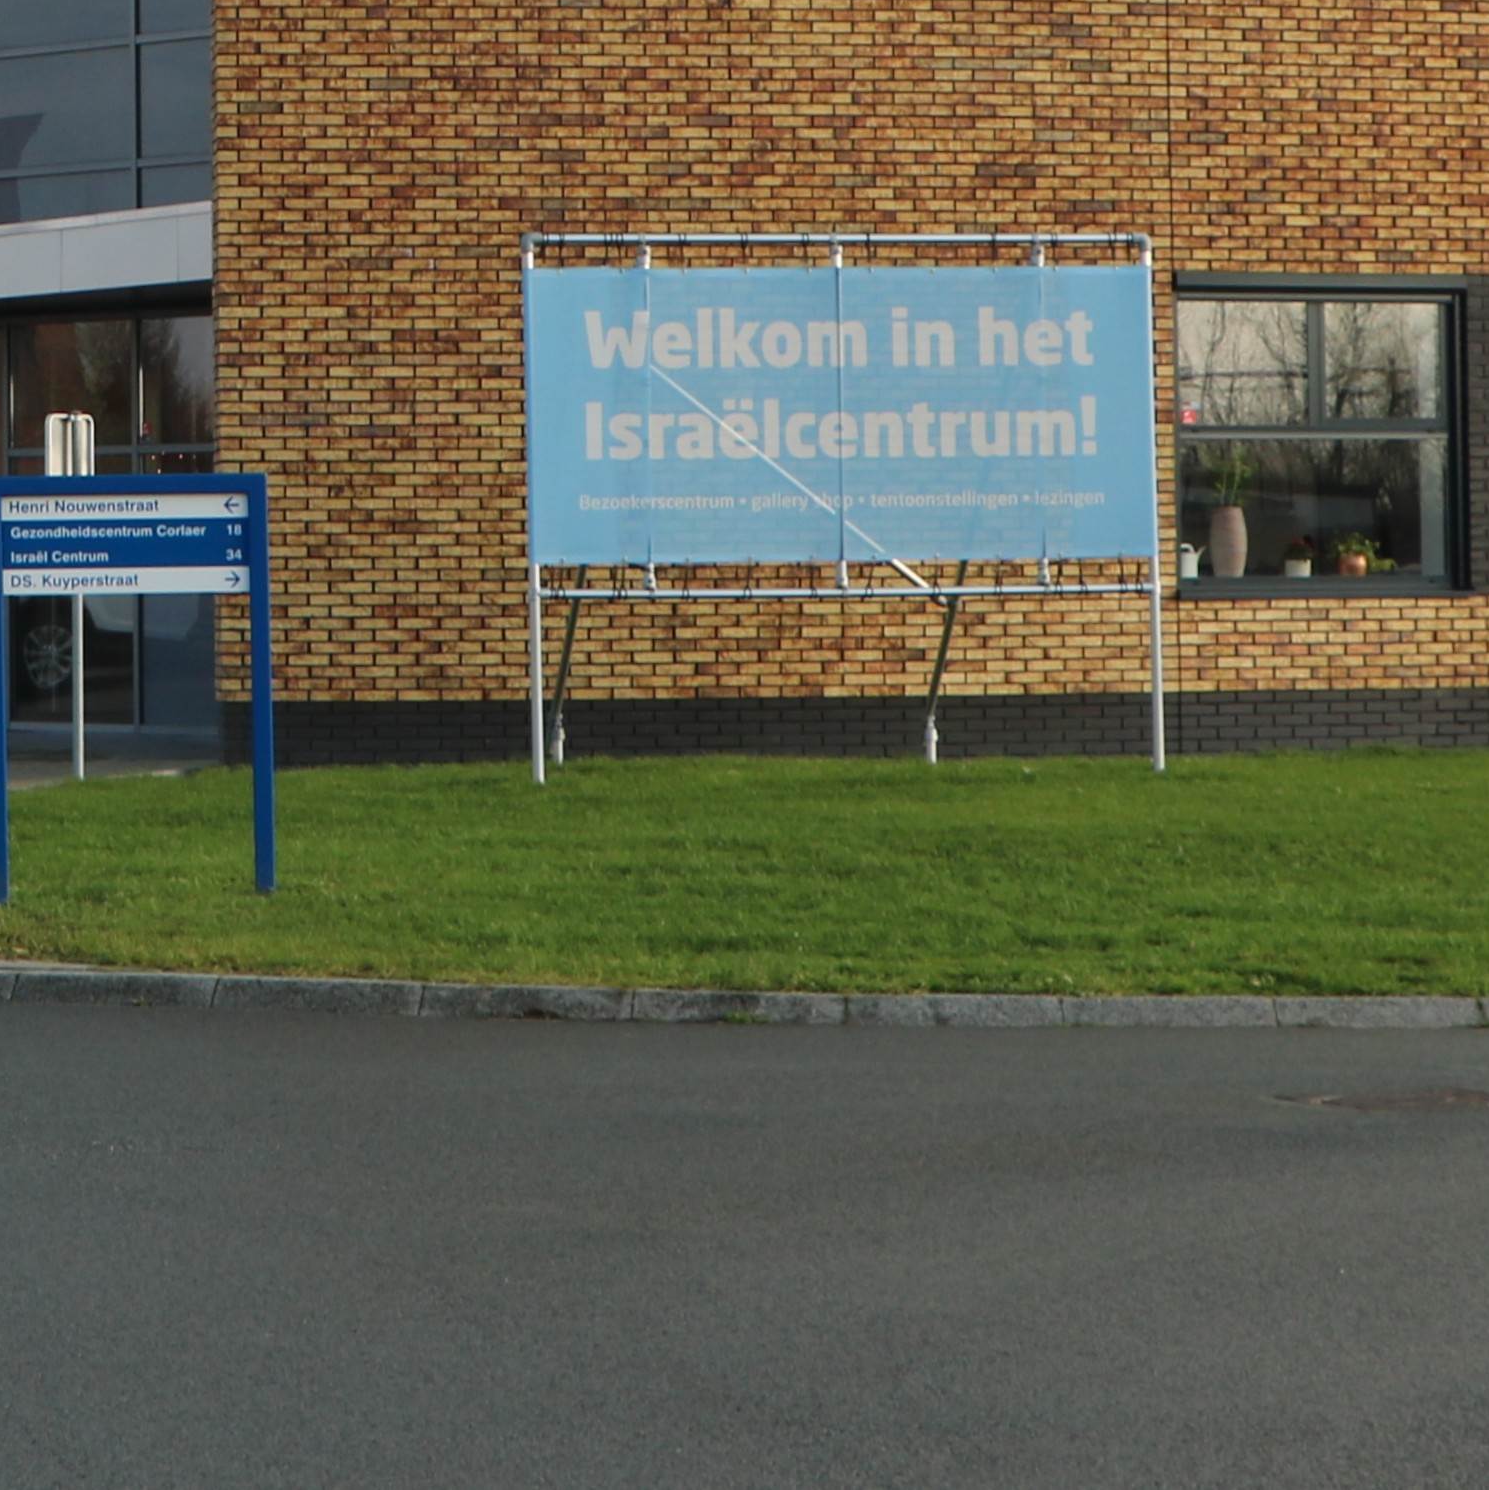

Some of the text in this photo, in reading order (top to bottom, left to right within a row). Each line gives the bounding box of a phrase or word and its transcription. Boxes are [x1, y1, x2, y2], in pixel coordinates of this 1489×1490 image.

[584, 306, 1094, 369] Welkom in het
[584, 396, 1098, 461] Israëlcentrum!
[9, 498, 160, 514] Henri Nouwenstraat
[579, 493, 735, 510] Bezoekerscentrum
[751, 493, 809, 511] gallery
[870, 489, 1018, 509] tentoonstellingen
[1034, 488, 1106, 507] lezingen
[9, 522, 242, 540] Gezondheidscentrum Corlaer 18
[9, 548, 243, 564] Israël Centrum 34
[9, 572, 139, 590] DS. Kuyperstraat
